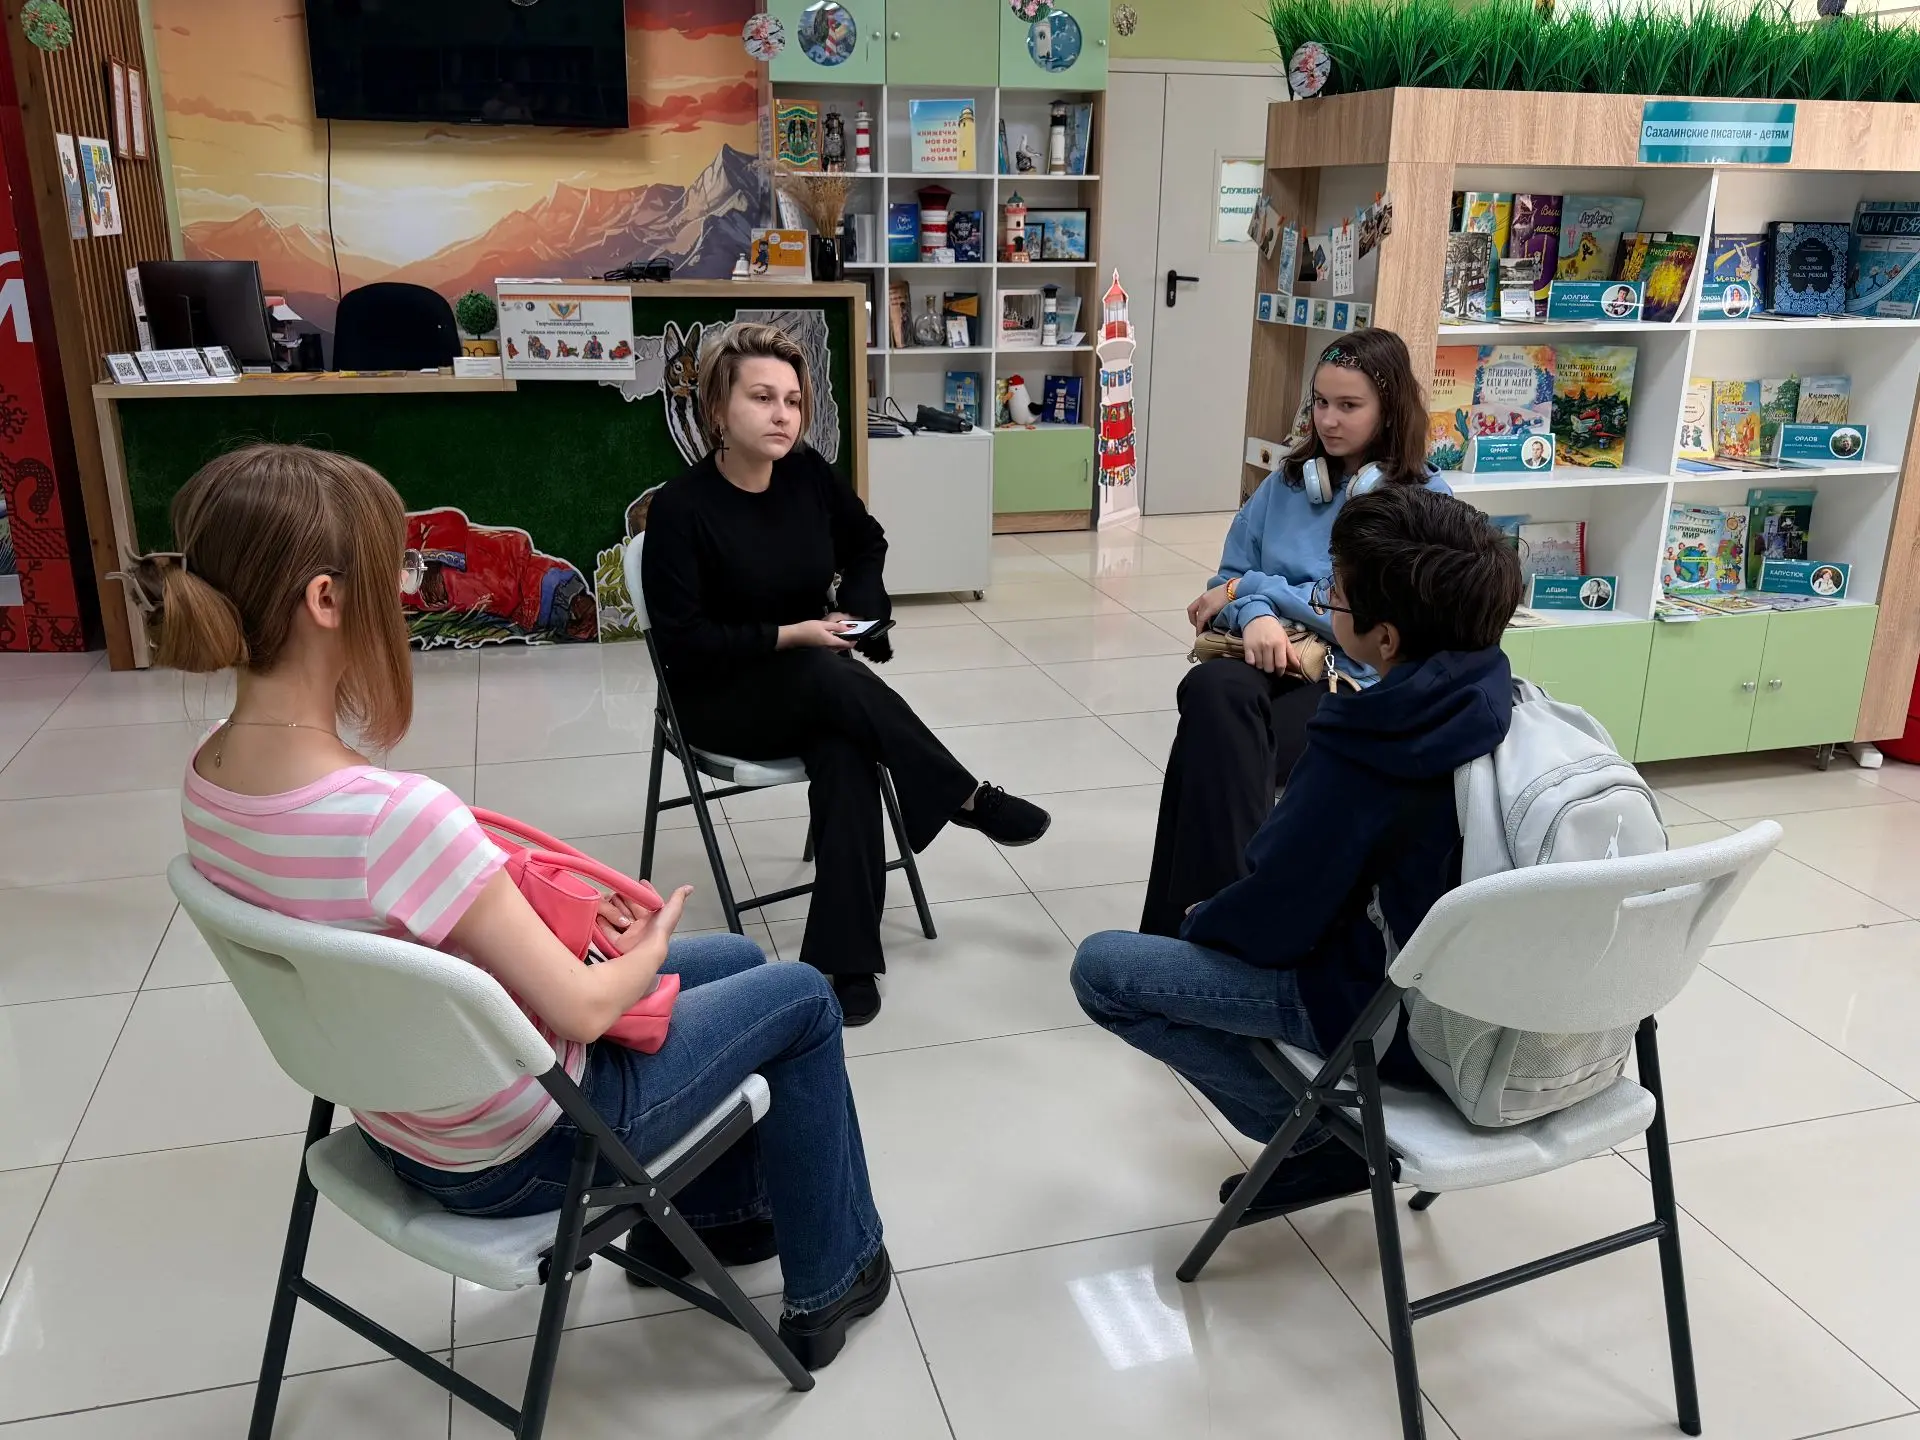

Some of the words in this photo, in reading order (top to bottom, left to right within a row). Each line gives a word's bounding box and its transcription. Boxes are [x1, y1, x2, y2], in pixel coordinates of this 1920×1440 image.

[1645, 125, 1708, 138] Сахалинские
[1710, 128, 1751, 139] писатели
[1759, 129, 1789, 140] детям
[1220, 186, 1262, 194] СЛУЖЕБНО
[1876, 216, 1892, 231] НА
[1487, 368, 1533, 378] ПРИКЛЮЧЕНИЯ
[1557, 363, 1617, 373] ПРИКЛЮЧЕНИЯ
[1486, 378, 1501, 387] КАТИ
[1511, 378, 1533, 387] МАРКА
[1669, 524, 1716, 535] ОКРУЖАЮЩИЙ
[1681, 531, 1700, 539] МИР
[1769, 569, 1804, 578] КАПУСТЮК
